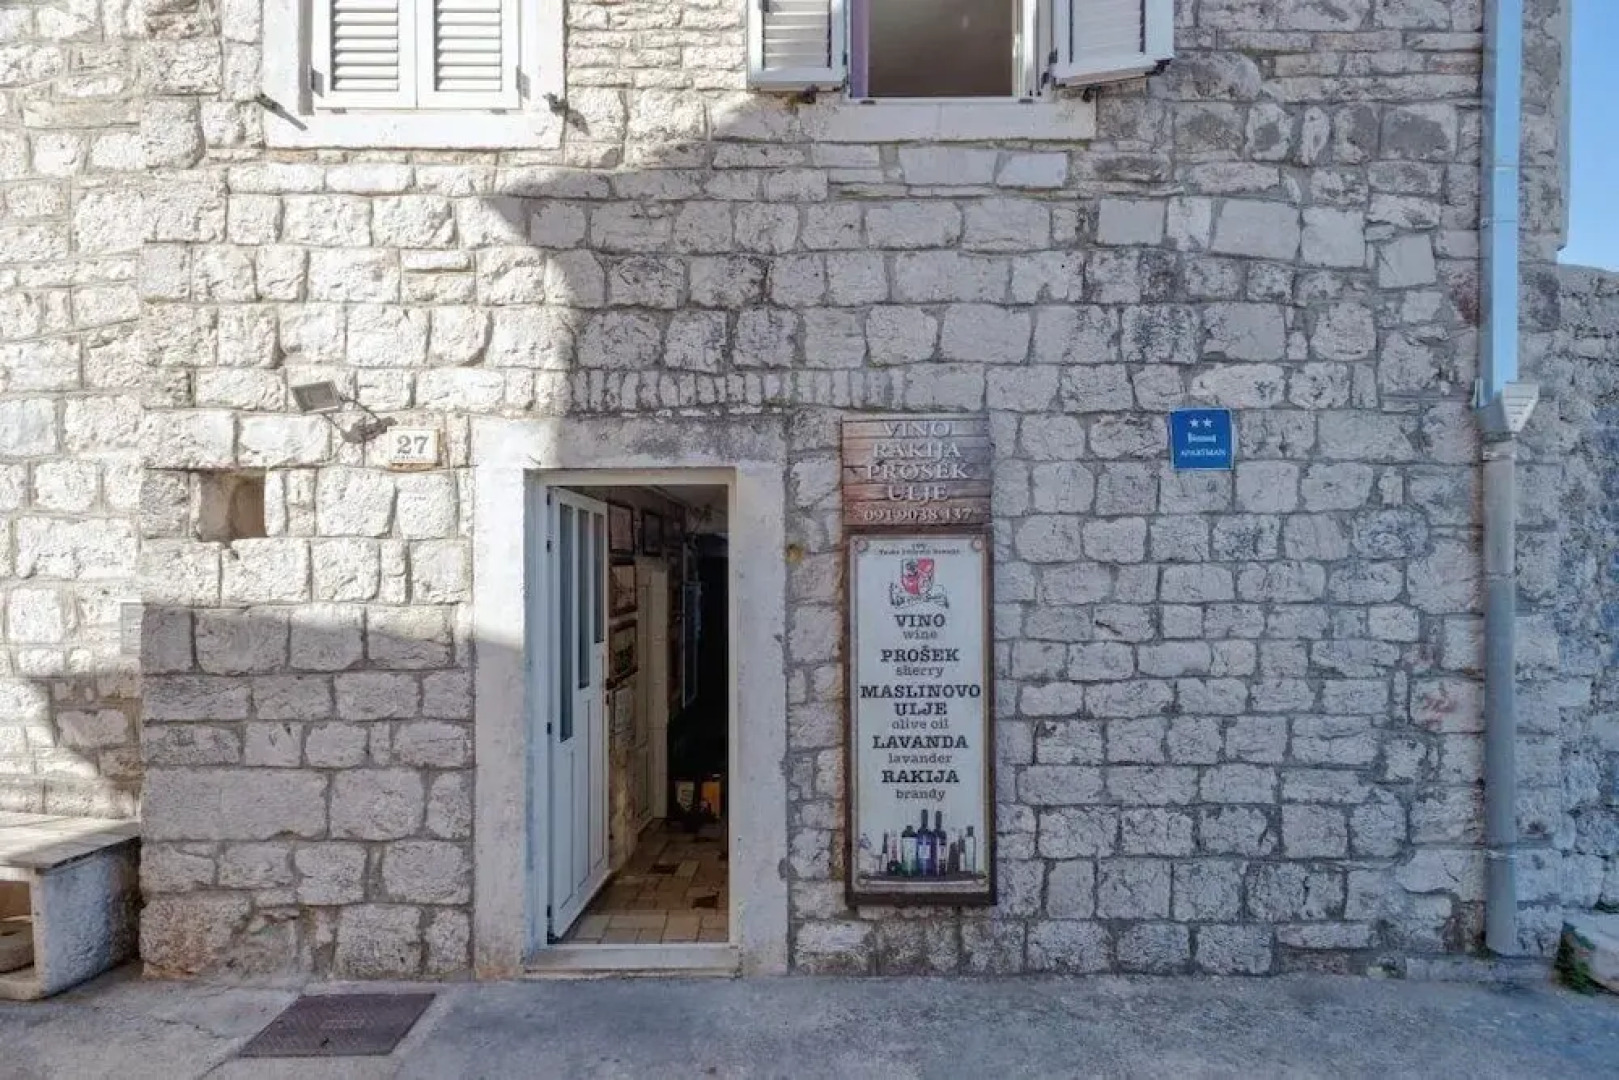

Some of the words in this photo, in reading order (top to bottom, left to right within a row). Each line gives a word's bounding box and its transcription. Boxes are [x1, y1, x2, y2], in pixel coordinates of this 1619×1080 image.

[883, 420, 950, 437] VINO
[397, 435, 429, 454] 27
[873, 441, 961, 461] RAKIJA
[888, 484, 948, 506] ULJE
[894, 614, 946, 628] VINO
[903, 629, 938, 640] wine
[881, 645, 960, 663] PROŠEK
[896, 665, 944, 678] sherry
[861, 684, 981, 699] MASLINOVO
[894, 702, 948, 716] ULJE
[892, 718, 927, 730] olive
[930, 717, 949, 730] oil
[873, 735, 969, 749] LAVANDA
[889, 752, 953, 764] lavander
[881, 770, 960, 783] RAKIJA
[896, 788, 946, 802] brandy
